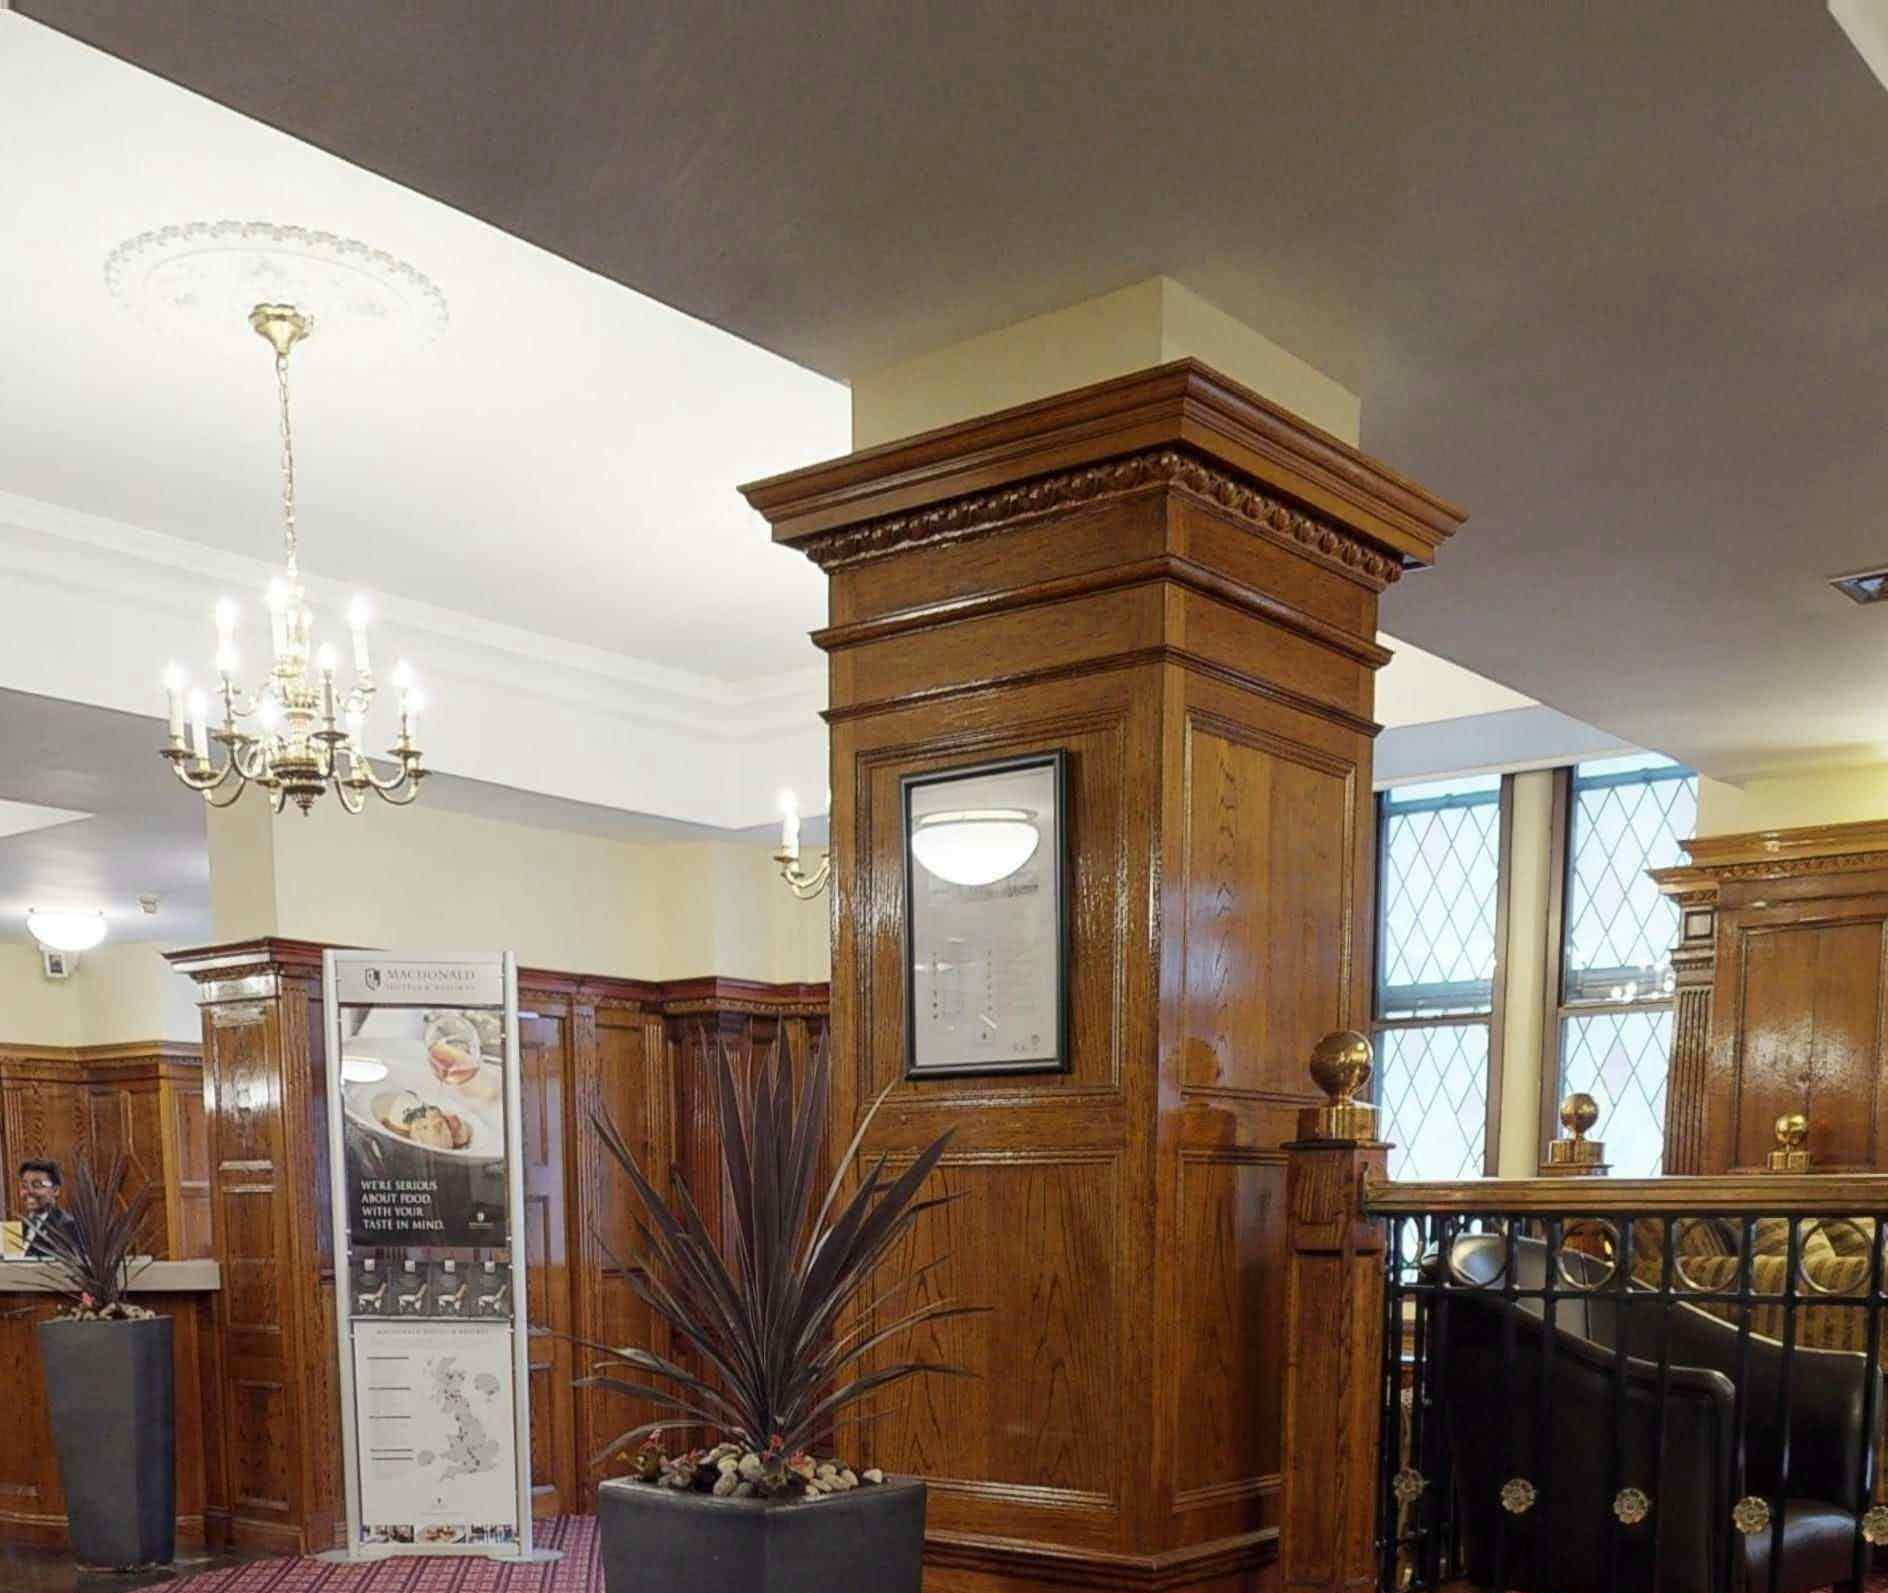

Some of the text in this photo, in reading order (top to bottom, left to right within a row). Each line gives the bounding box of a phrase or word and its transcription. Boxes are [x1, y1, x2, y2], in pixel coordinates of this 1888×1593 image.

[395, 1180, 439, 1193] SERIOUS
[361, 1192, 397, 1205] ABOUT
[361, 1205, 424, 1217] WITH YOUR
[363, 1219, 393, 1231] TASTE
[396, 1219, 410, 1230] IN
